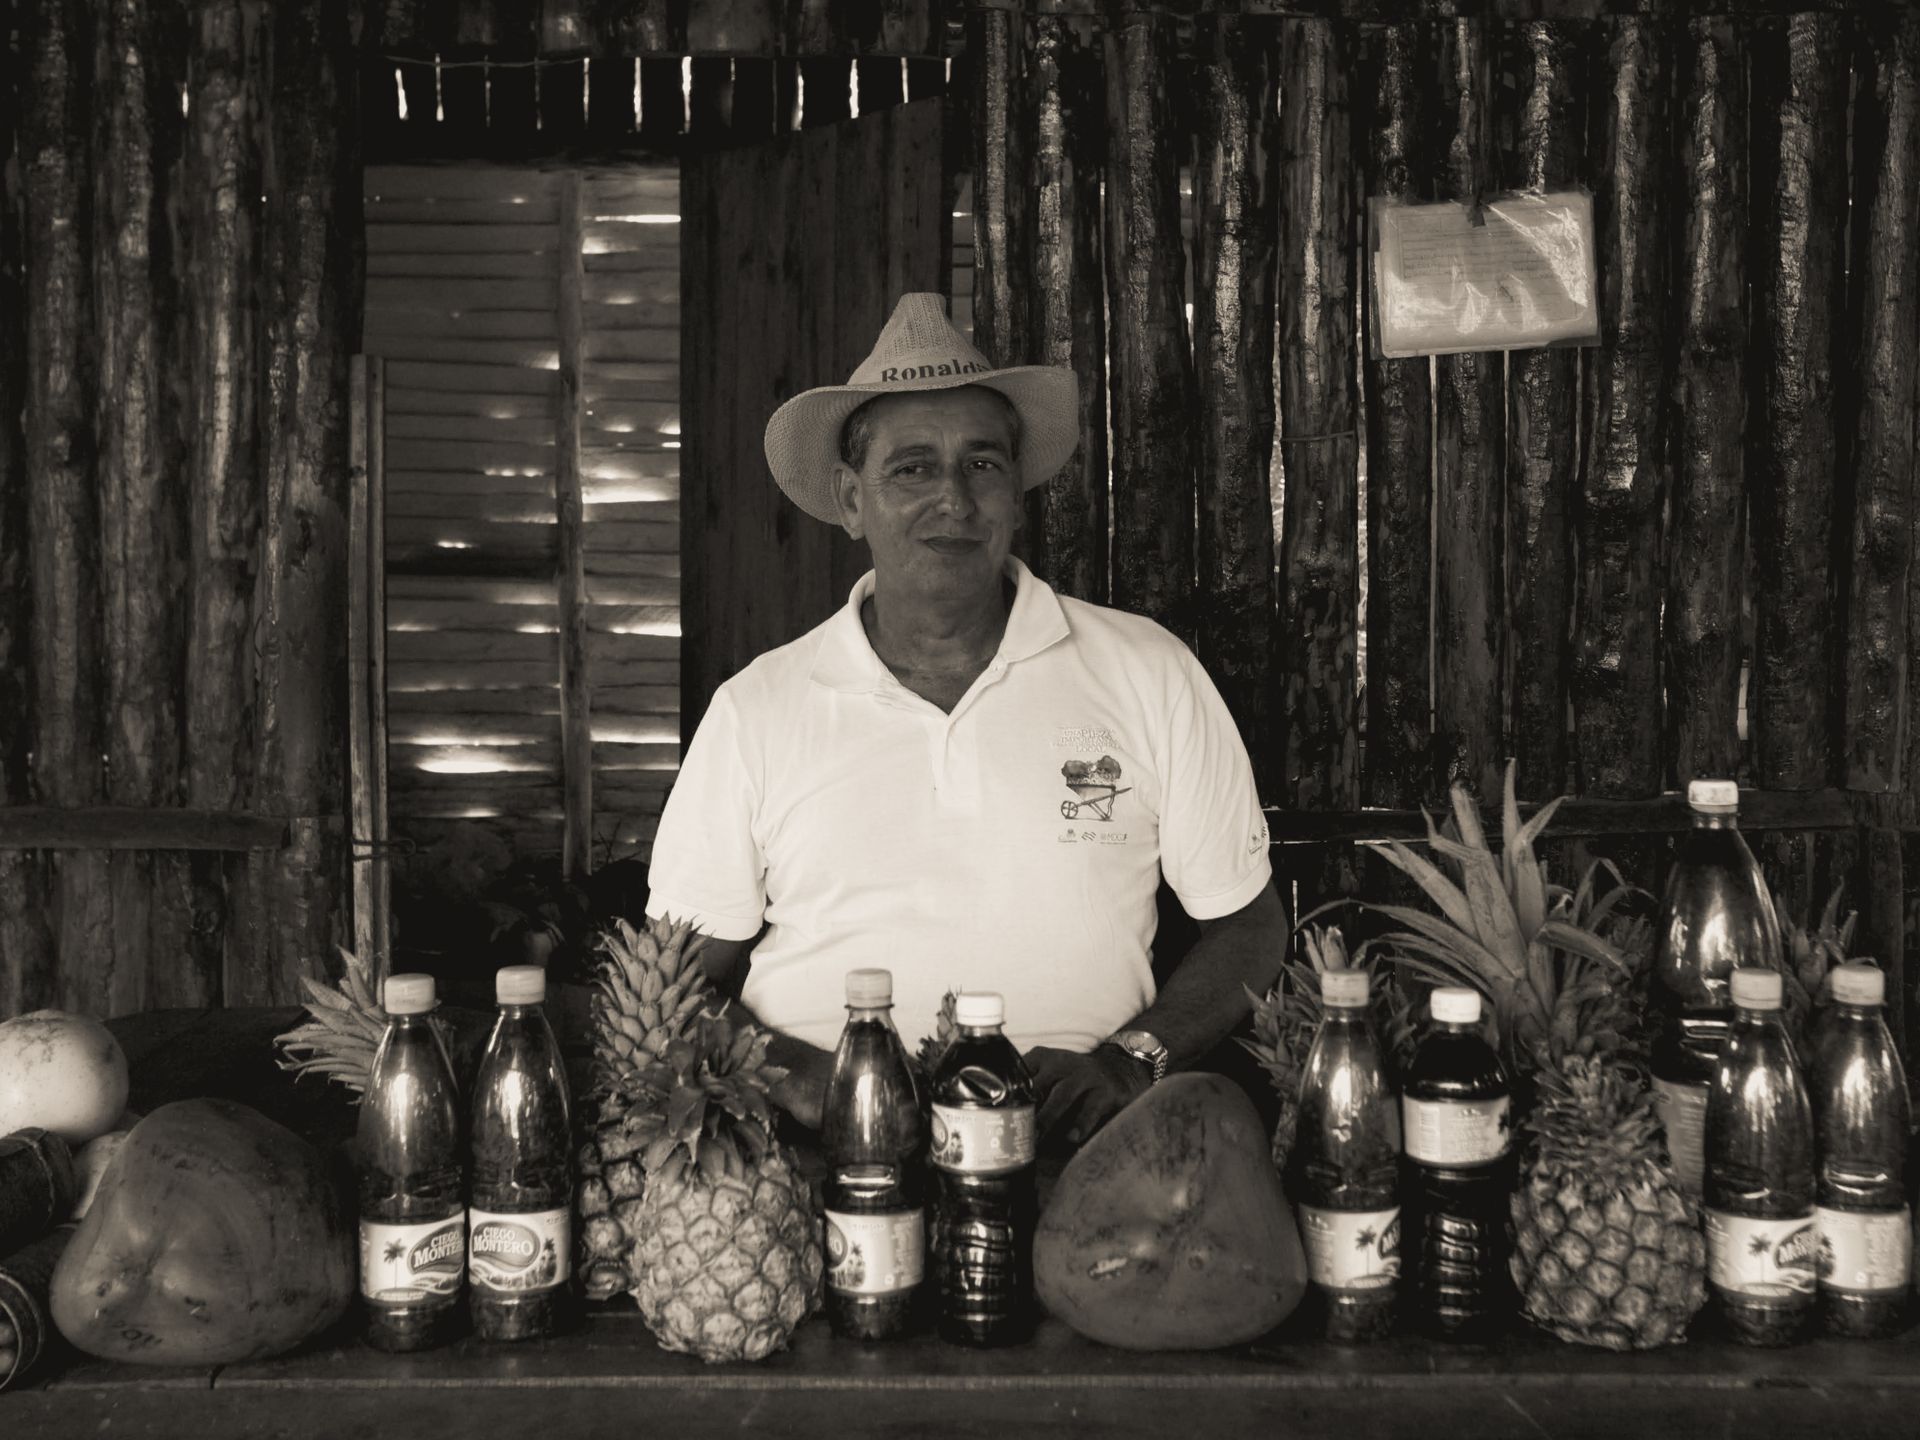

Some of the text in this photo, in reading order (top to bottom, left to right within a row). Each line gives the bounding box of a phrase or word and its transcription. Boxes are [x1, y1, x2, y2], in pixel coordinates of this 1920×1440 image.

[483, 1227, 516, 1241] CIEGO
[413, 1237, 464, 1268] MONTE
[473, 1235, 534, 1257] MONTERO
